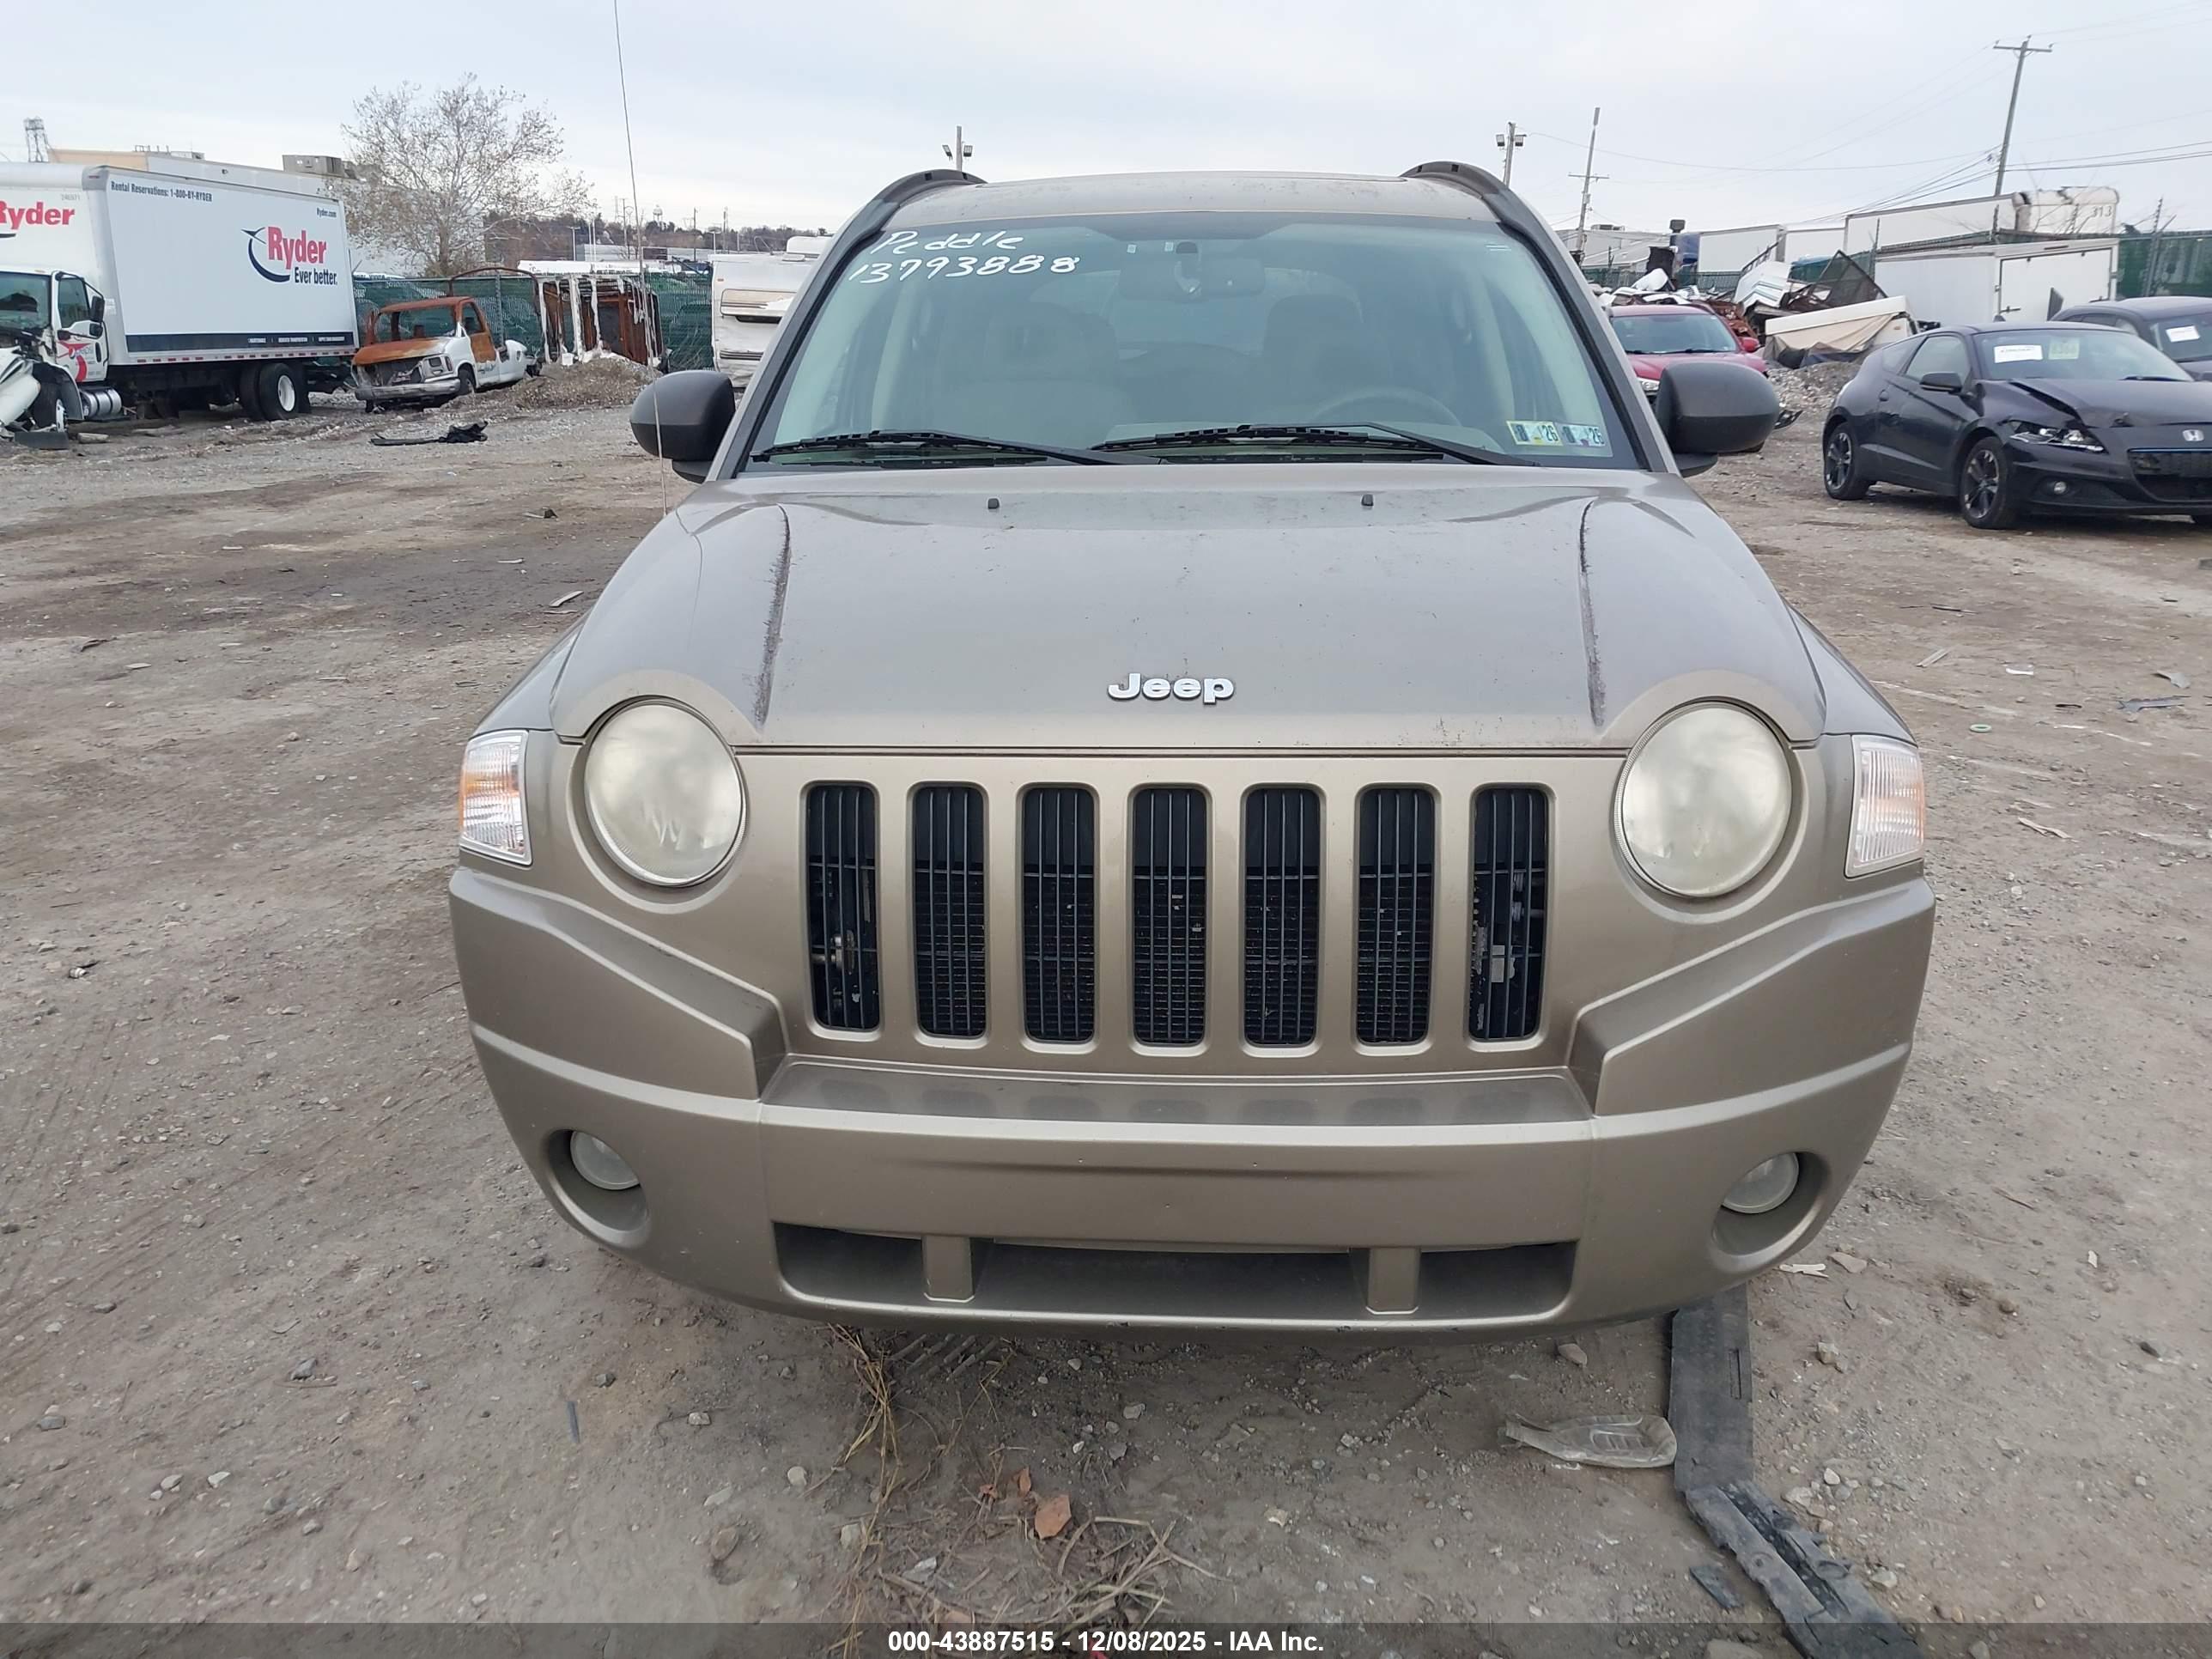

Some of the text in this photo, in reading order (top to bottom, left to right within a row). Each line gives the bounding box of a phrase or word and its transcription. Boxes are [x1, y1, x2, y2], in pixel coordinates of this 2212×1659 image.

[111, 180, 212, 202] Rental Reservations: 1-800-BY-RYDER
[316, 207, 337, 218] Ryder.com
[267, 226, 327, 270] Ryder
[294, 266, 338, 286] Ever better.
[848, 254, 1080, 284] 13793888
[1107, 672, 1235, 706] Jeep
